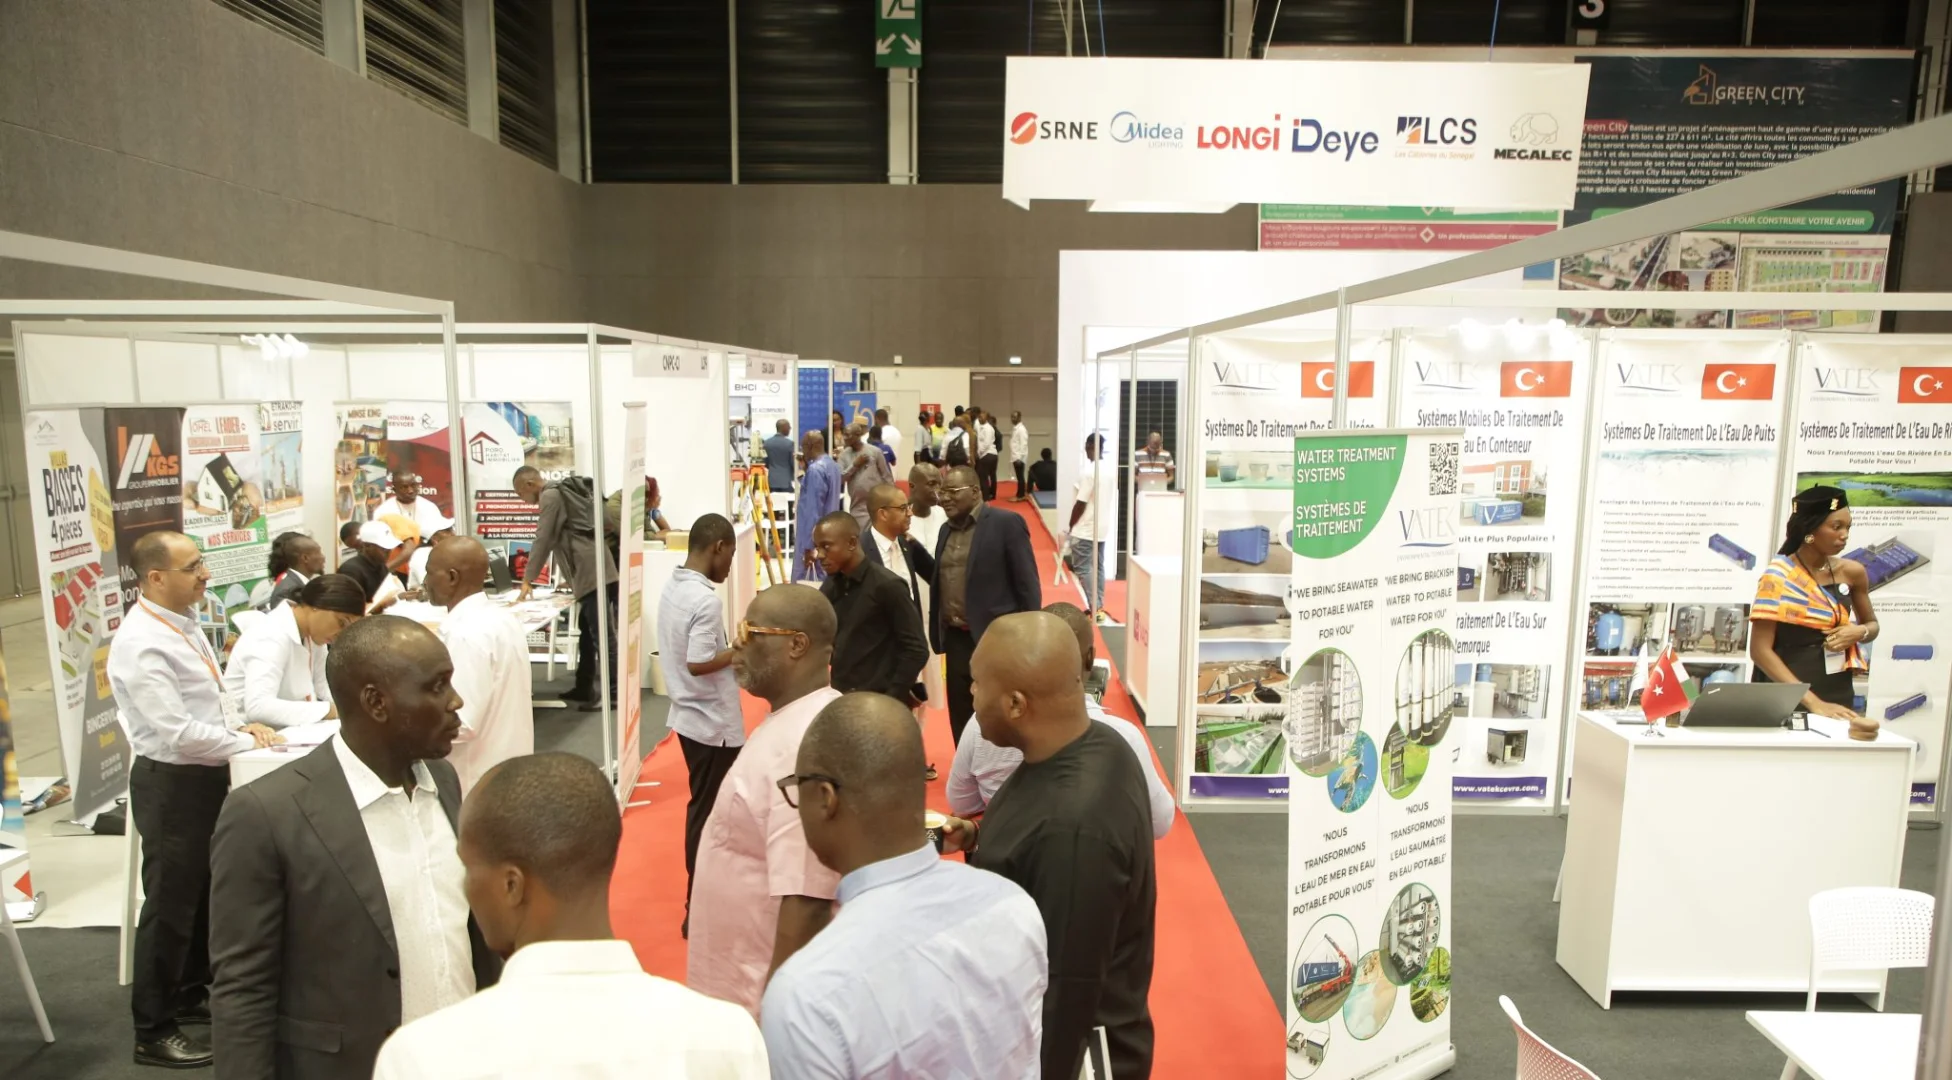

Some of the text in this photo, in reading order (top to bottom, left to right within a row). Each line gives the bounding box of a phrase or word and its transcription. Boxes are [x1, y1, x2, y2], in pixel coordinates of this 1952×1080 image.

[1715, 86, 1805, 101] GREEN CITY
[1040, 121, 1098, 140] SRNE
[1121, 122, 1184, 140] Midea
[1424, 116, 1478, 145] LCS
[1494, 148, 1573, 162] MEGALEC
[734, 384, 757, 392] BHCI
[1417, 408, 1564, 428] Systèmes Mobiles De Traitement De
[1205, 418, 1244, 441] Systèmes
[1246, 420, 1258, 437] De
[1604, 421, 1776, 442] Systèmes De Traitement De L'Eau De Puits
[1800, 421, 1838, 442] Systèmes
[1840, 422, 1850, 438] De
[1852, 422, 1894, 439] Traitement
[1896, 422, 1907, 439] De
[1908, 422, 1930, 439] L'Eau
[1932, 422, 1943, 439] De
[1476, 436, 1486, 453] En
[1488, 437, 1532, 454] Conteneur
[1297, 446, 1396, 464] WATER TREATMENT
[146, 454, 179, 478] KGS
[1296, 466, 1346, 483] SYSTEMS
[42, 464, 86, 518] BASSES
[1296, 499, 1366, 520] SYSTÈMES DE
[52, 520, 58, 543] 4
[59, 516, 82, 550] pièces
[1296, 518, 1363, 538] TRAITEMENT
[208, 530, 252, 546] NOS SERVICES
[1506, 535, 1548, 543] Populaire
[1400, 572, 1422, 584] BRING
[1424, 568, 1454, 580] BRACKISH
[1294, 578, 1378, 599] "WE BRING SEAWATER
[1386, 588, 1452, 606] WATER TO POTABLE
[1298, 600, 1374, 620] TO POTABLE WATER
[1390, 615, 1416, 626] WATER
[1418, 611, 1433, 622] FOR
[1456, 612, 1547, 629] raitement De L'Eau Sur
[1319, 624, 1354, 639] FOR YOU"
[1405, 802, 1429, 815] "NOUS
[1322, 826, 1348, 842] "NOUS
[1390, 816, 1446, 841] TRANSFORMONS
[1304, 842, 1366, 870] TRANSFORMONS
[1390, 834, 1446, 861] L'EAU SAUMÂTRE
[1295, 858, 1376, 895] L'EAU DE MER EN EAU
[1389, 870, 1398, 882] EN
[1398, 866, 1412, 879] EAU
[1293, 878, 1375, 916] POTABLE POUR VOUS"
